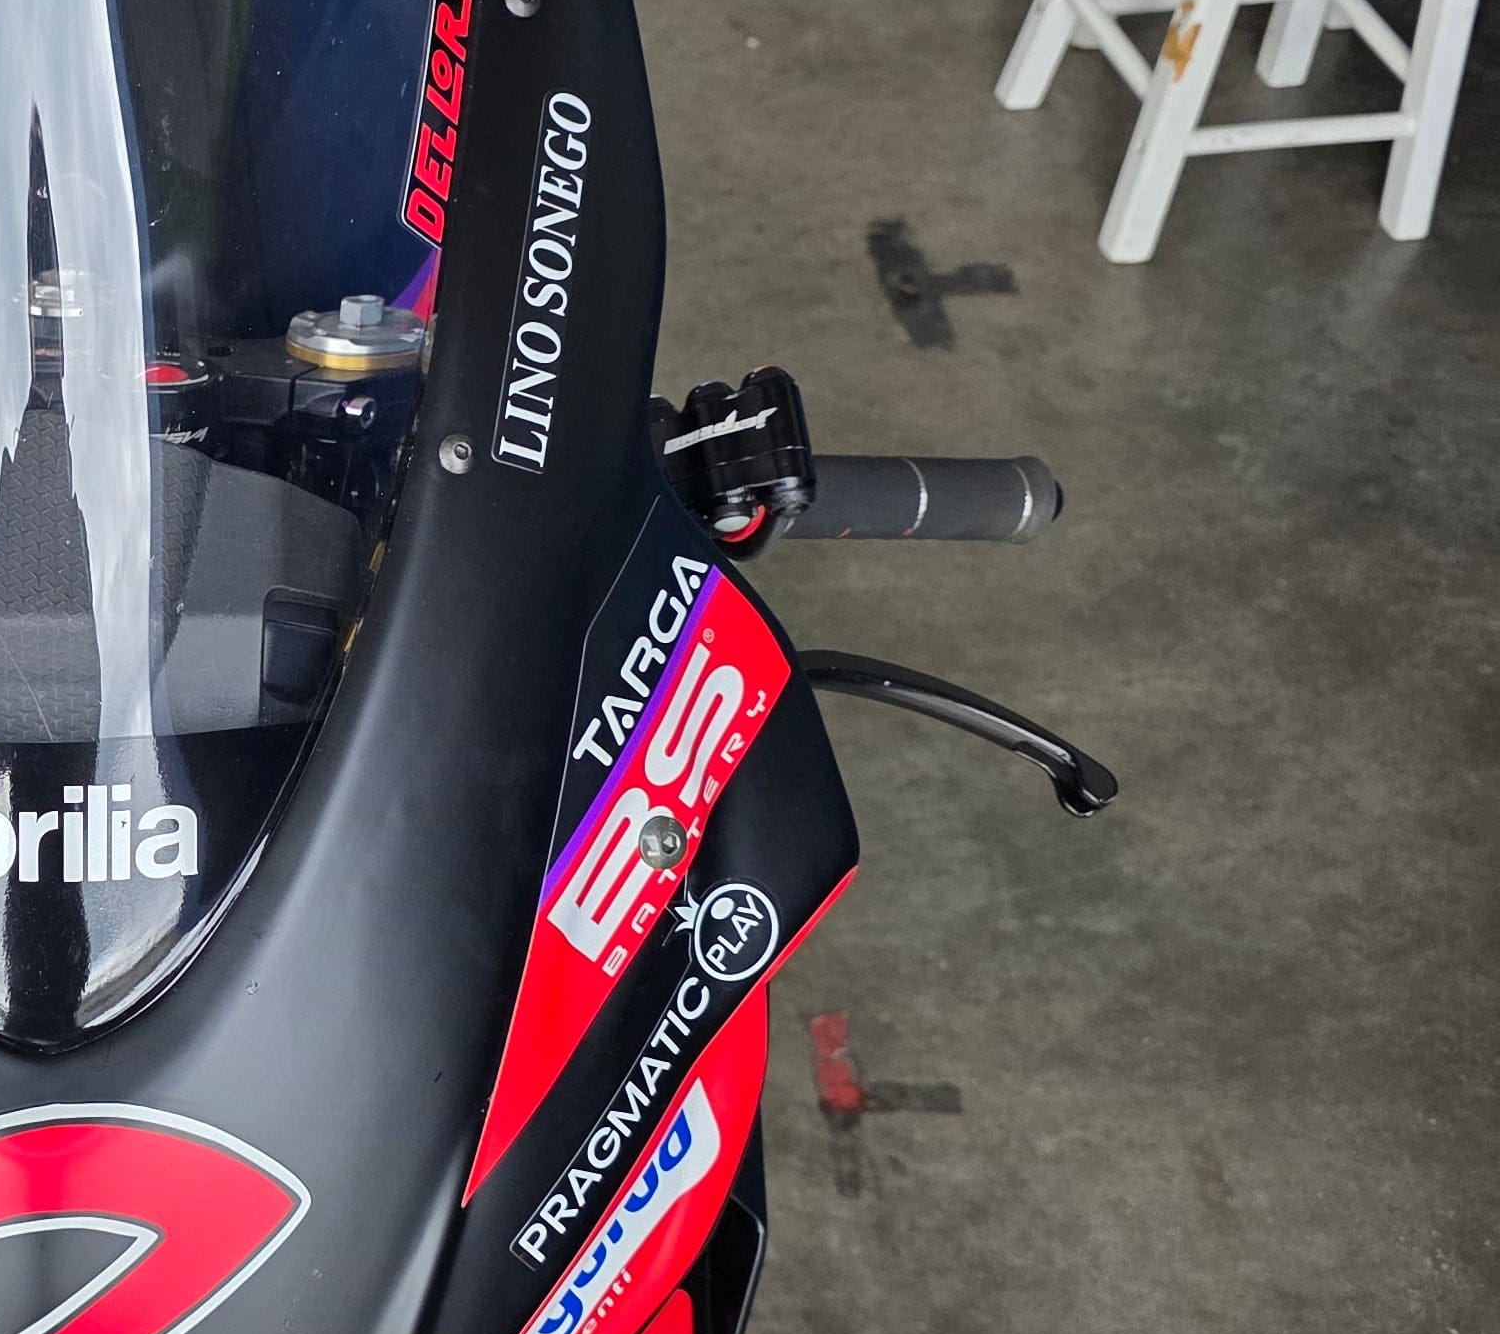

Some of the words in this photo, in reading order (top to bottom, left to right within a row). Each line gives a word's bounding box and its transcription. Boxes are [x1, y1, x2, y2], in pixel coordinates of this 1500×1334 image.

[522, 92, 592, 317] SONEGO
[499, 321, 562, 468] LINO
[572, 555, 708, 766] TARGA
[518, 976, 711, 1263] PRAGMATIC
[706, 893, 764, 973] PLAY
